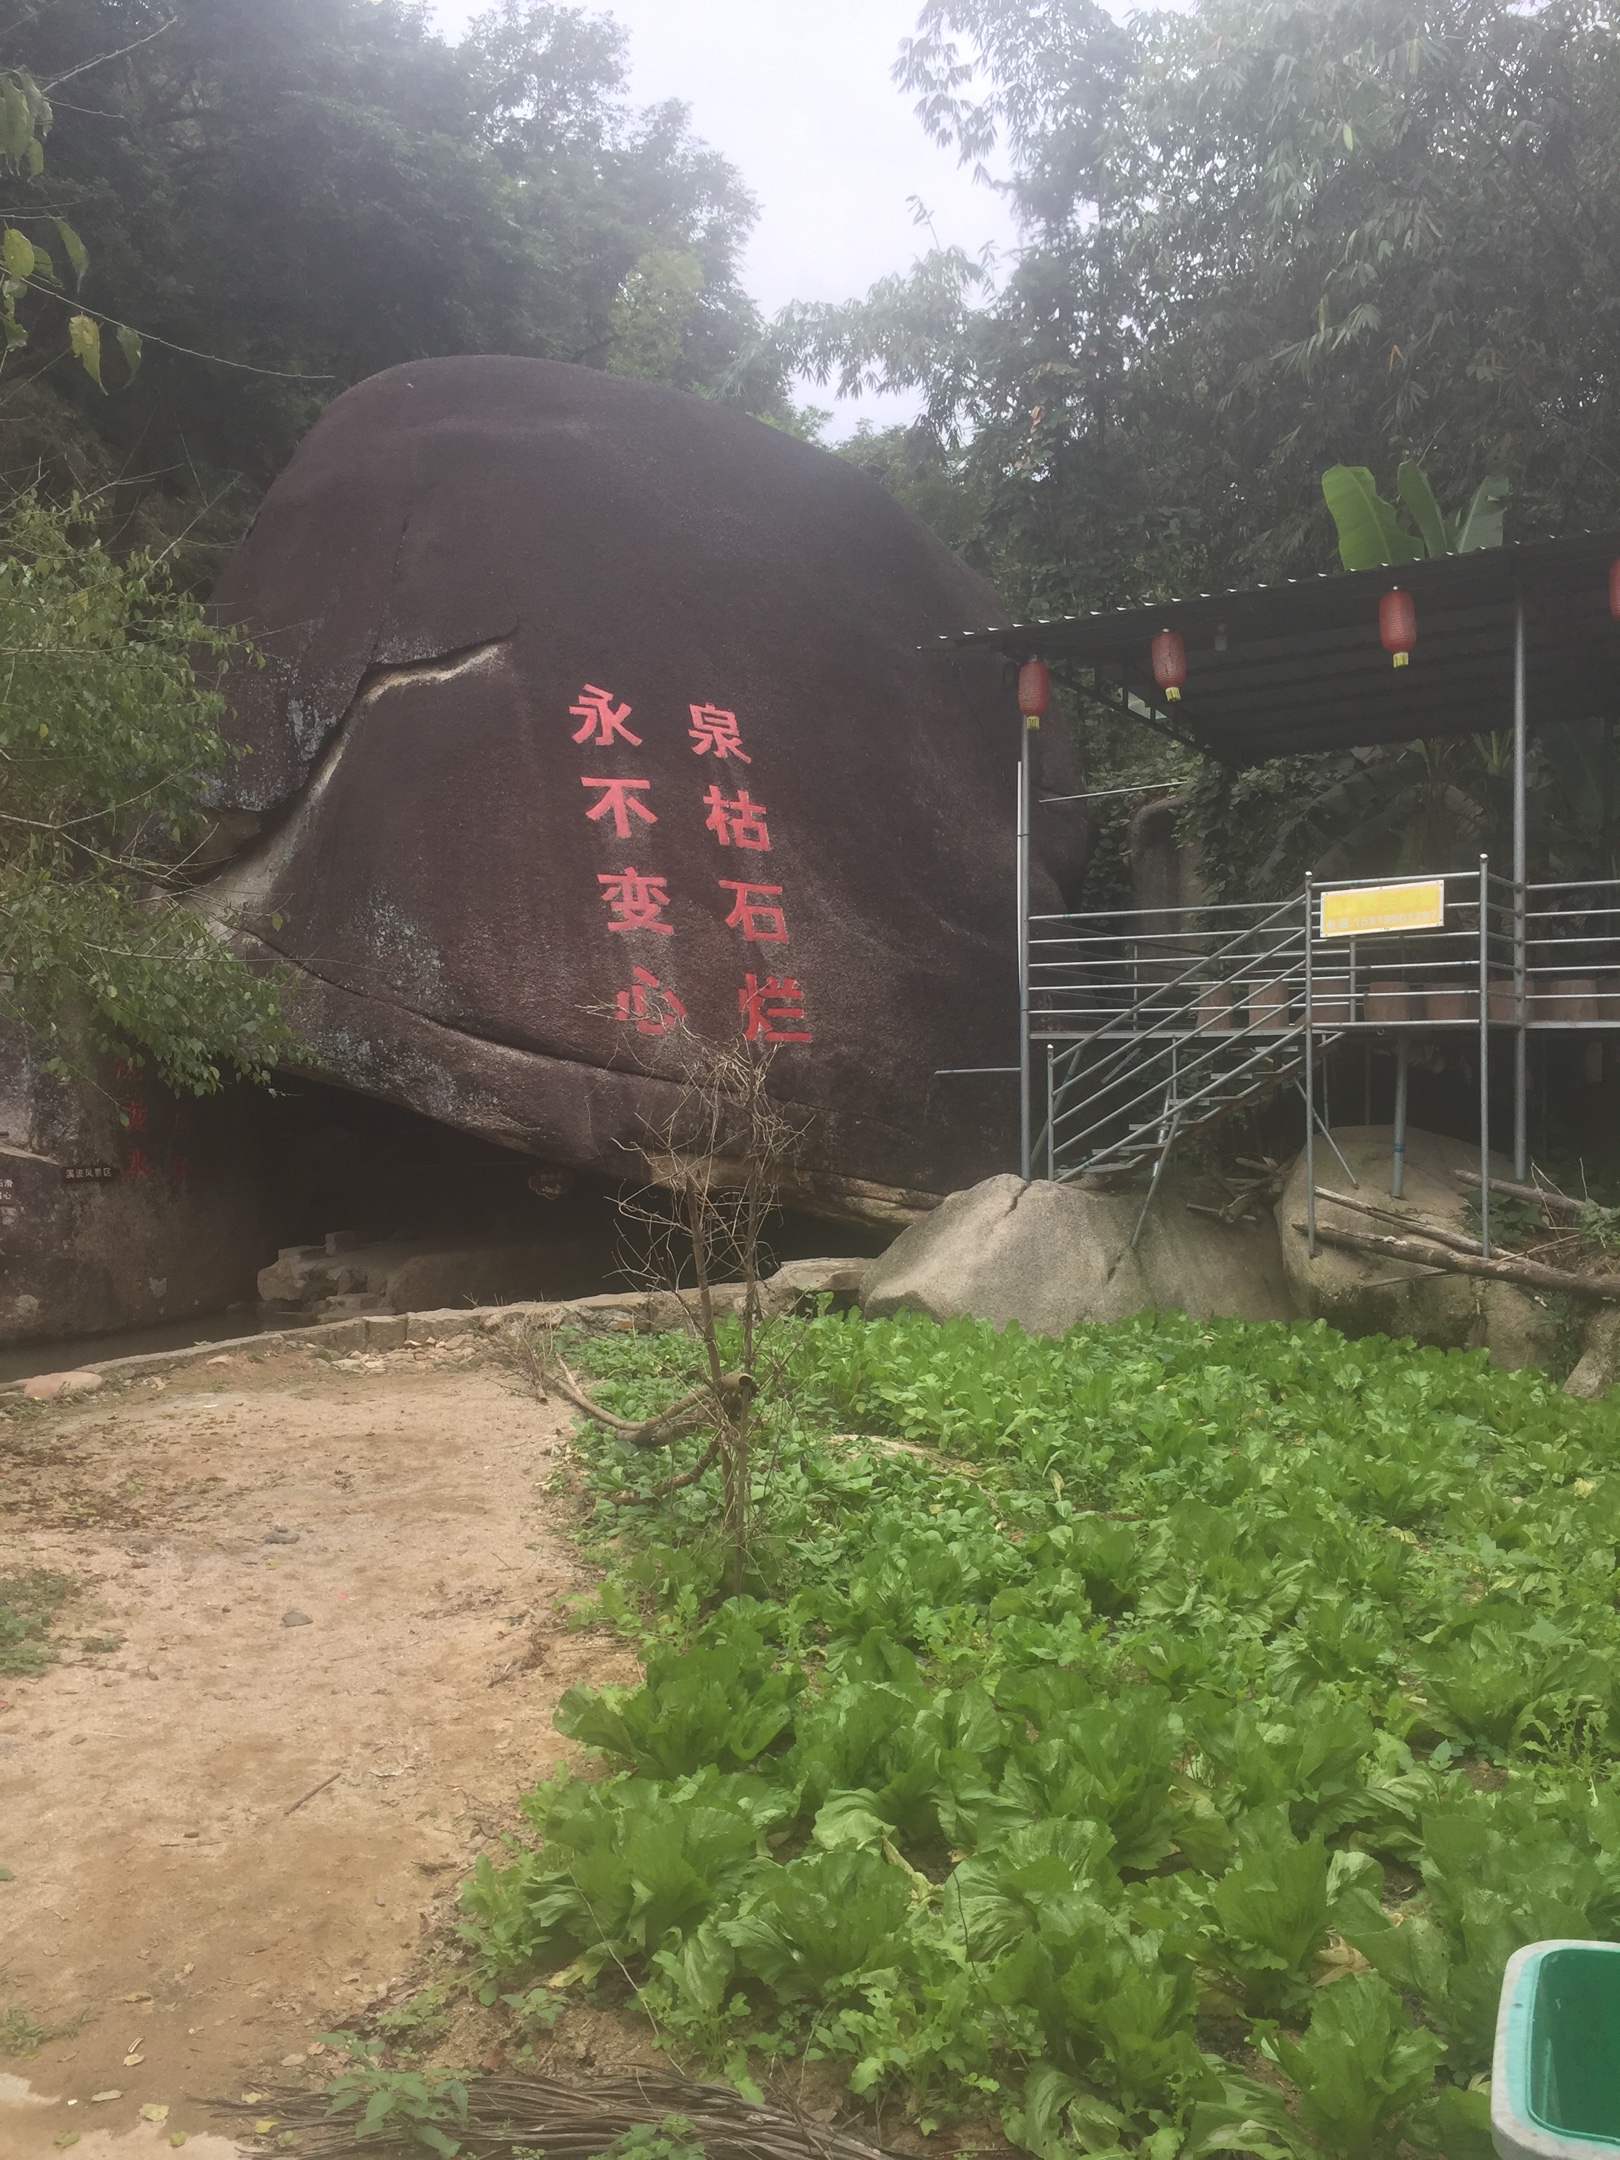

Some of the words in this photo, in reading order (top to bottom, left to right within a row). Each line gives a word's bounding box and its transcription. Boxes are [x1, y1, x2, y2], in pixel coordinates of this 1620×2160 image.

[569, 683, 687, 1035] 永不变心
[688, 703, 812, 1043] 泉枯石烂
